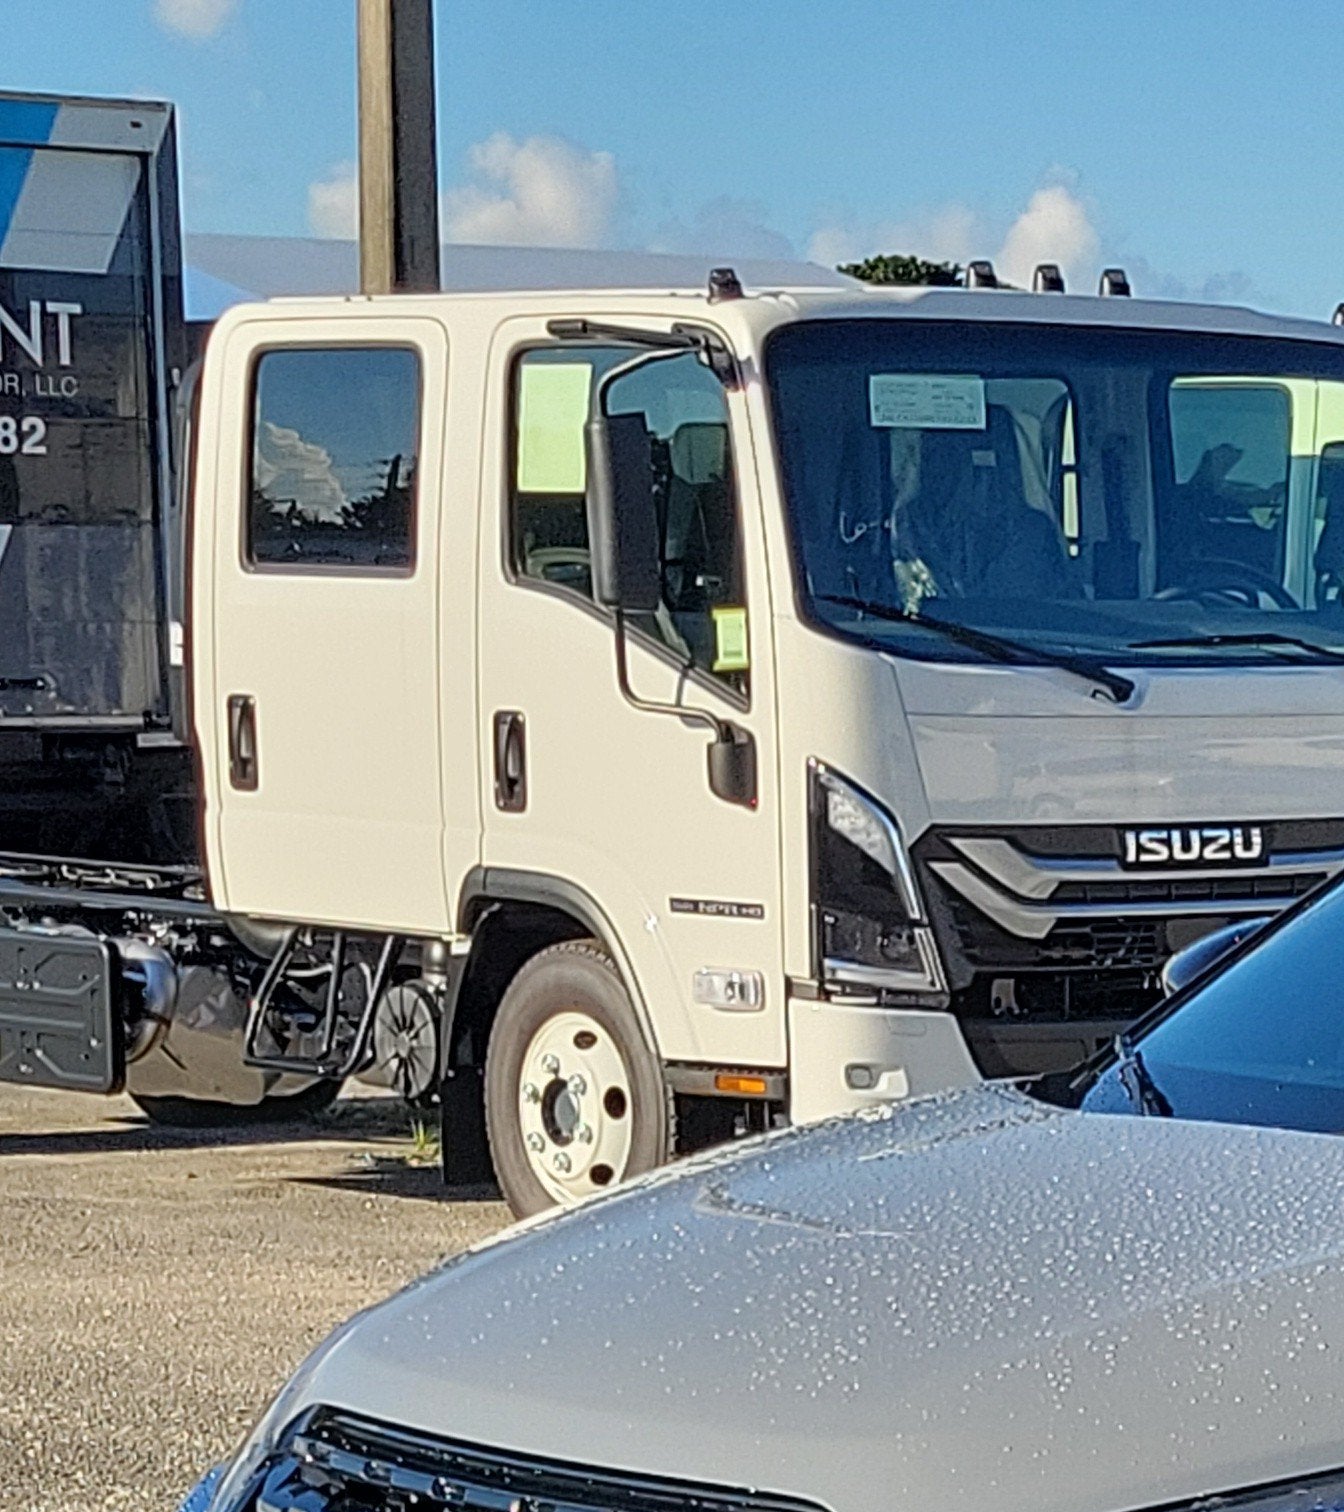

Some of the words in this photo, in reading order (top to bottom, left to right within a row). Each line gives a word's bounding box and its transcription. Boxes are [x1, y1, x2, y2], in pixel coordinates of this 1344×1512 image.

[35, 375, 79, 398] LLC
[0, 415, 48, 456] 82
[1124, 827, 1263, 863] ISUZU
